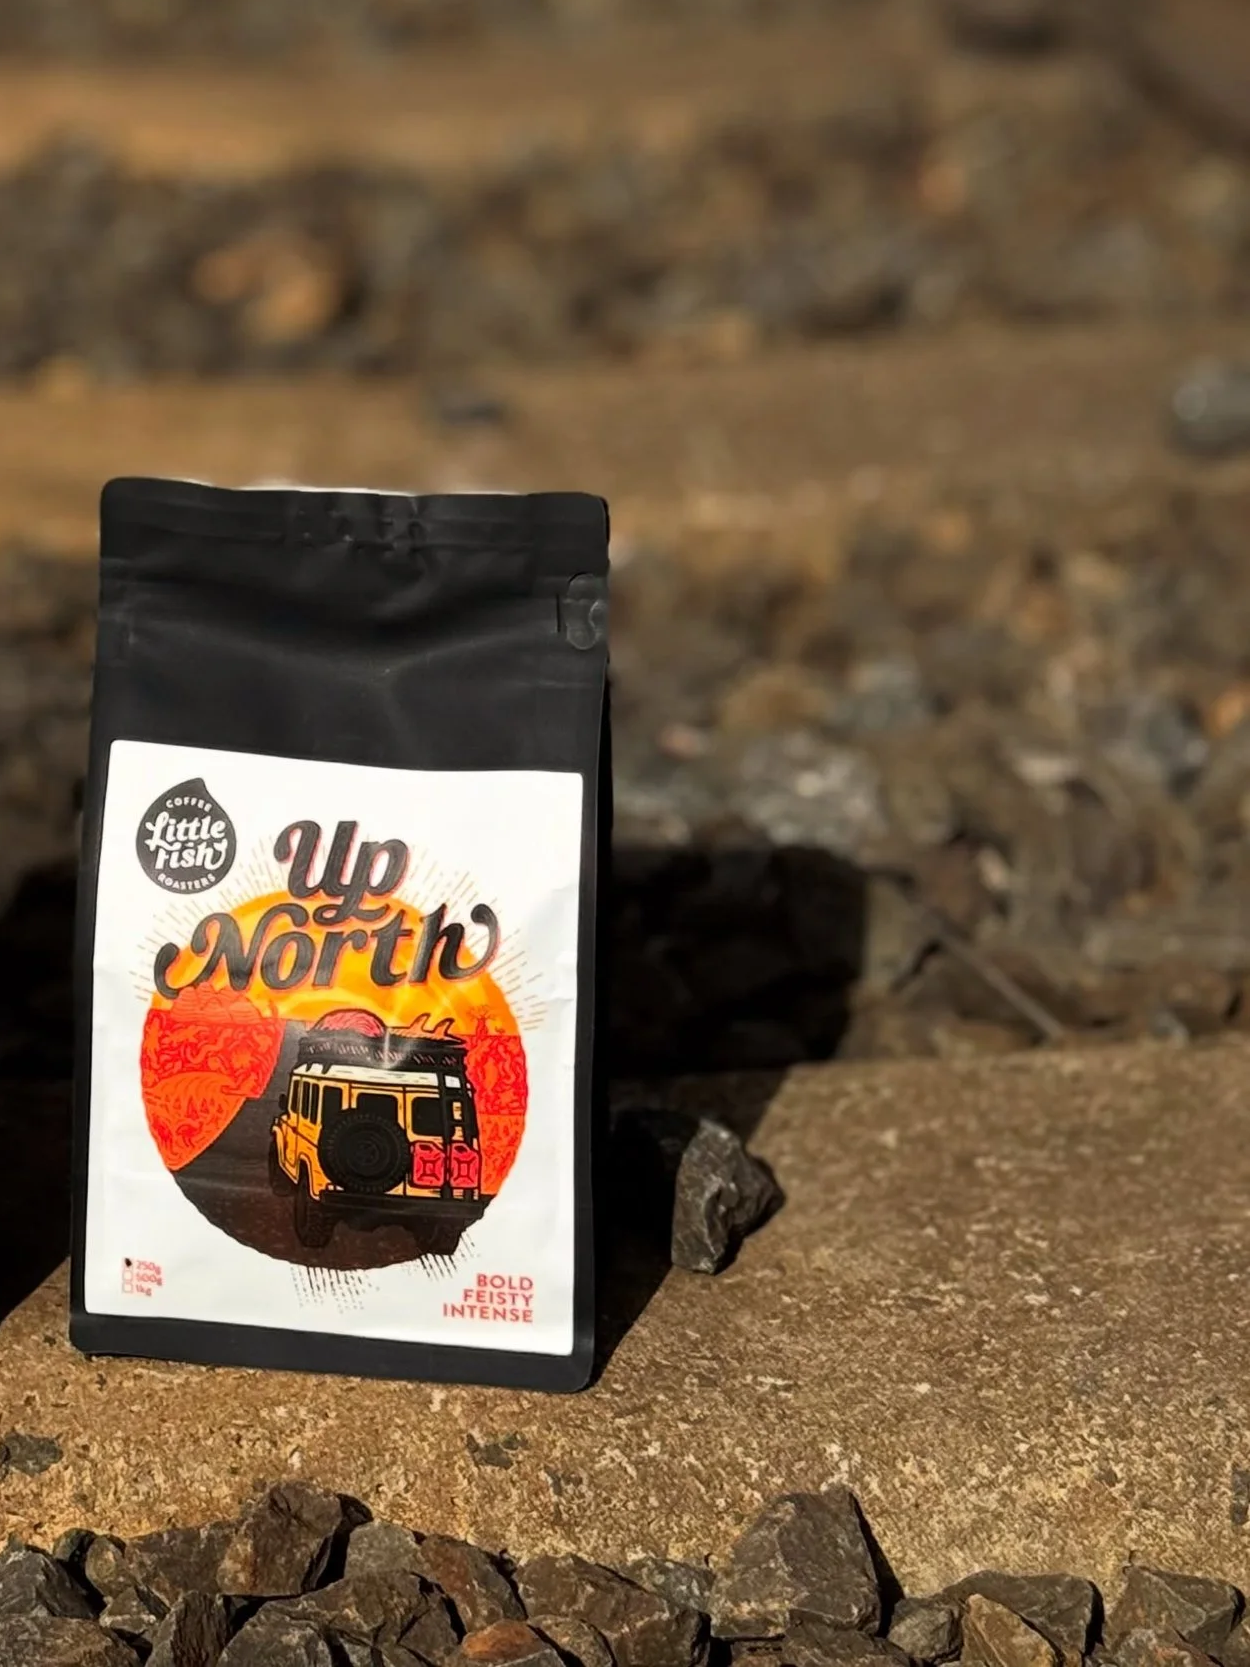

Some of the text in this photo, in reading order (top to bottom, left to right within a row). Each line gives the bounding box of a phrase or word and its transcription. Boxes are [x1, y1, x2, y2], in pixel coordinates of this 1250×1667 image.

[166, 796, 213, 812] COFFEE
[144, 811, 226, 852] Little
[154, 838, 228, 871] Fish
[157, 873, 216, 890] ROASTERS
[272, 820, 410, 926] Up
[154, 903, 499, 999] North
[477, 1273, 534, 1291] BOLD
[463, 1288, 533, 1307] FEISTY
[443, 1303, 533, 1323] INTENSE
